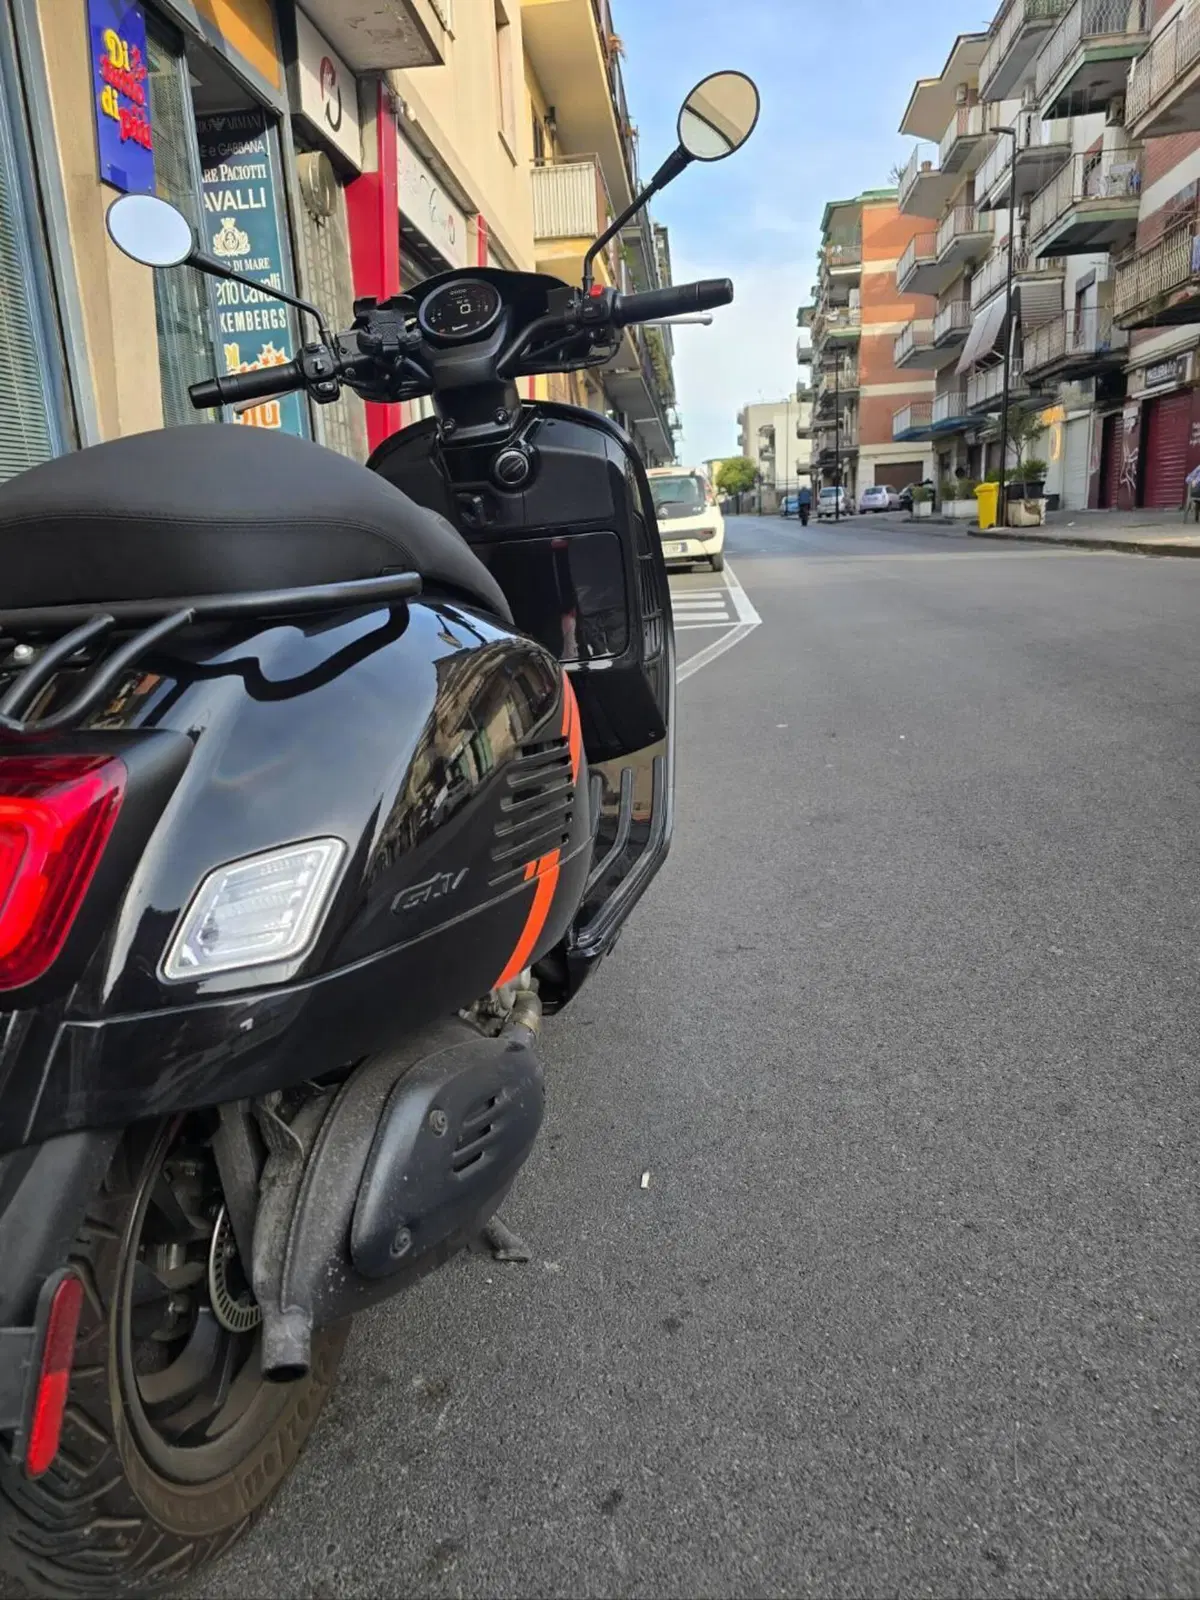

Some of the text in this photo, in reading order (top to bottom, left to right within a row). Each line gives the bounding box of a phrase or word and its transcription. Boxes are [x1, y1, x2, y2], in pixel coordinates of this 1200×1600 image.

[104, 28, 130, 72] Di
[218, 140, 265, 156] GABBANA
[218, 164, 267, 182] PACIOTTI
[233, 260, 243, 271] DI
[245, 257, 271, 271] MARE
[219, 308, 287, 333] KEMBERGS
